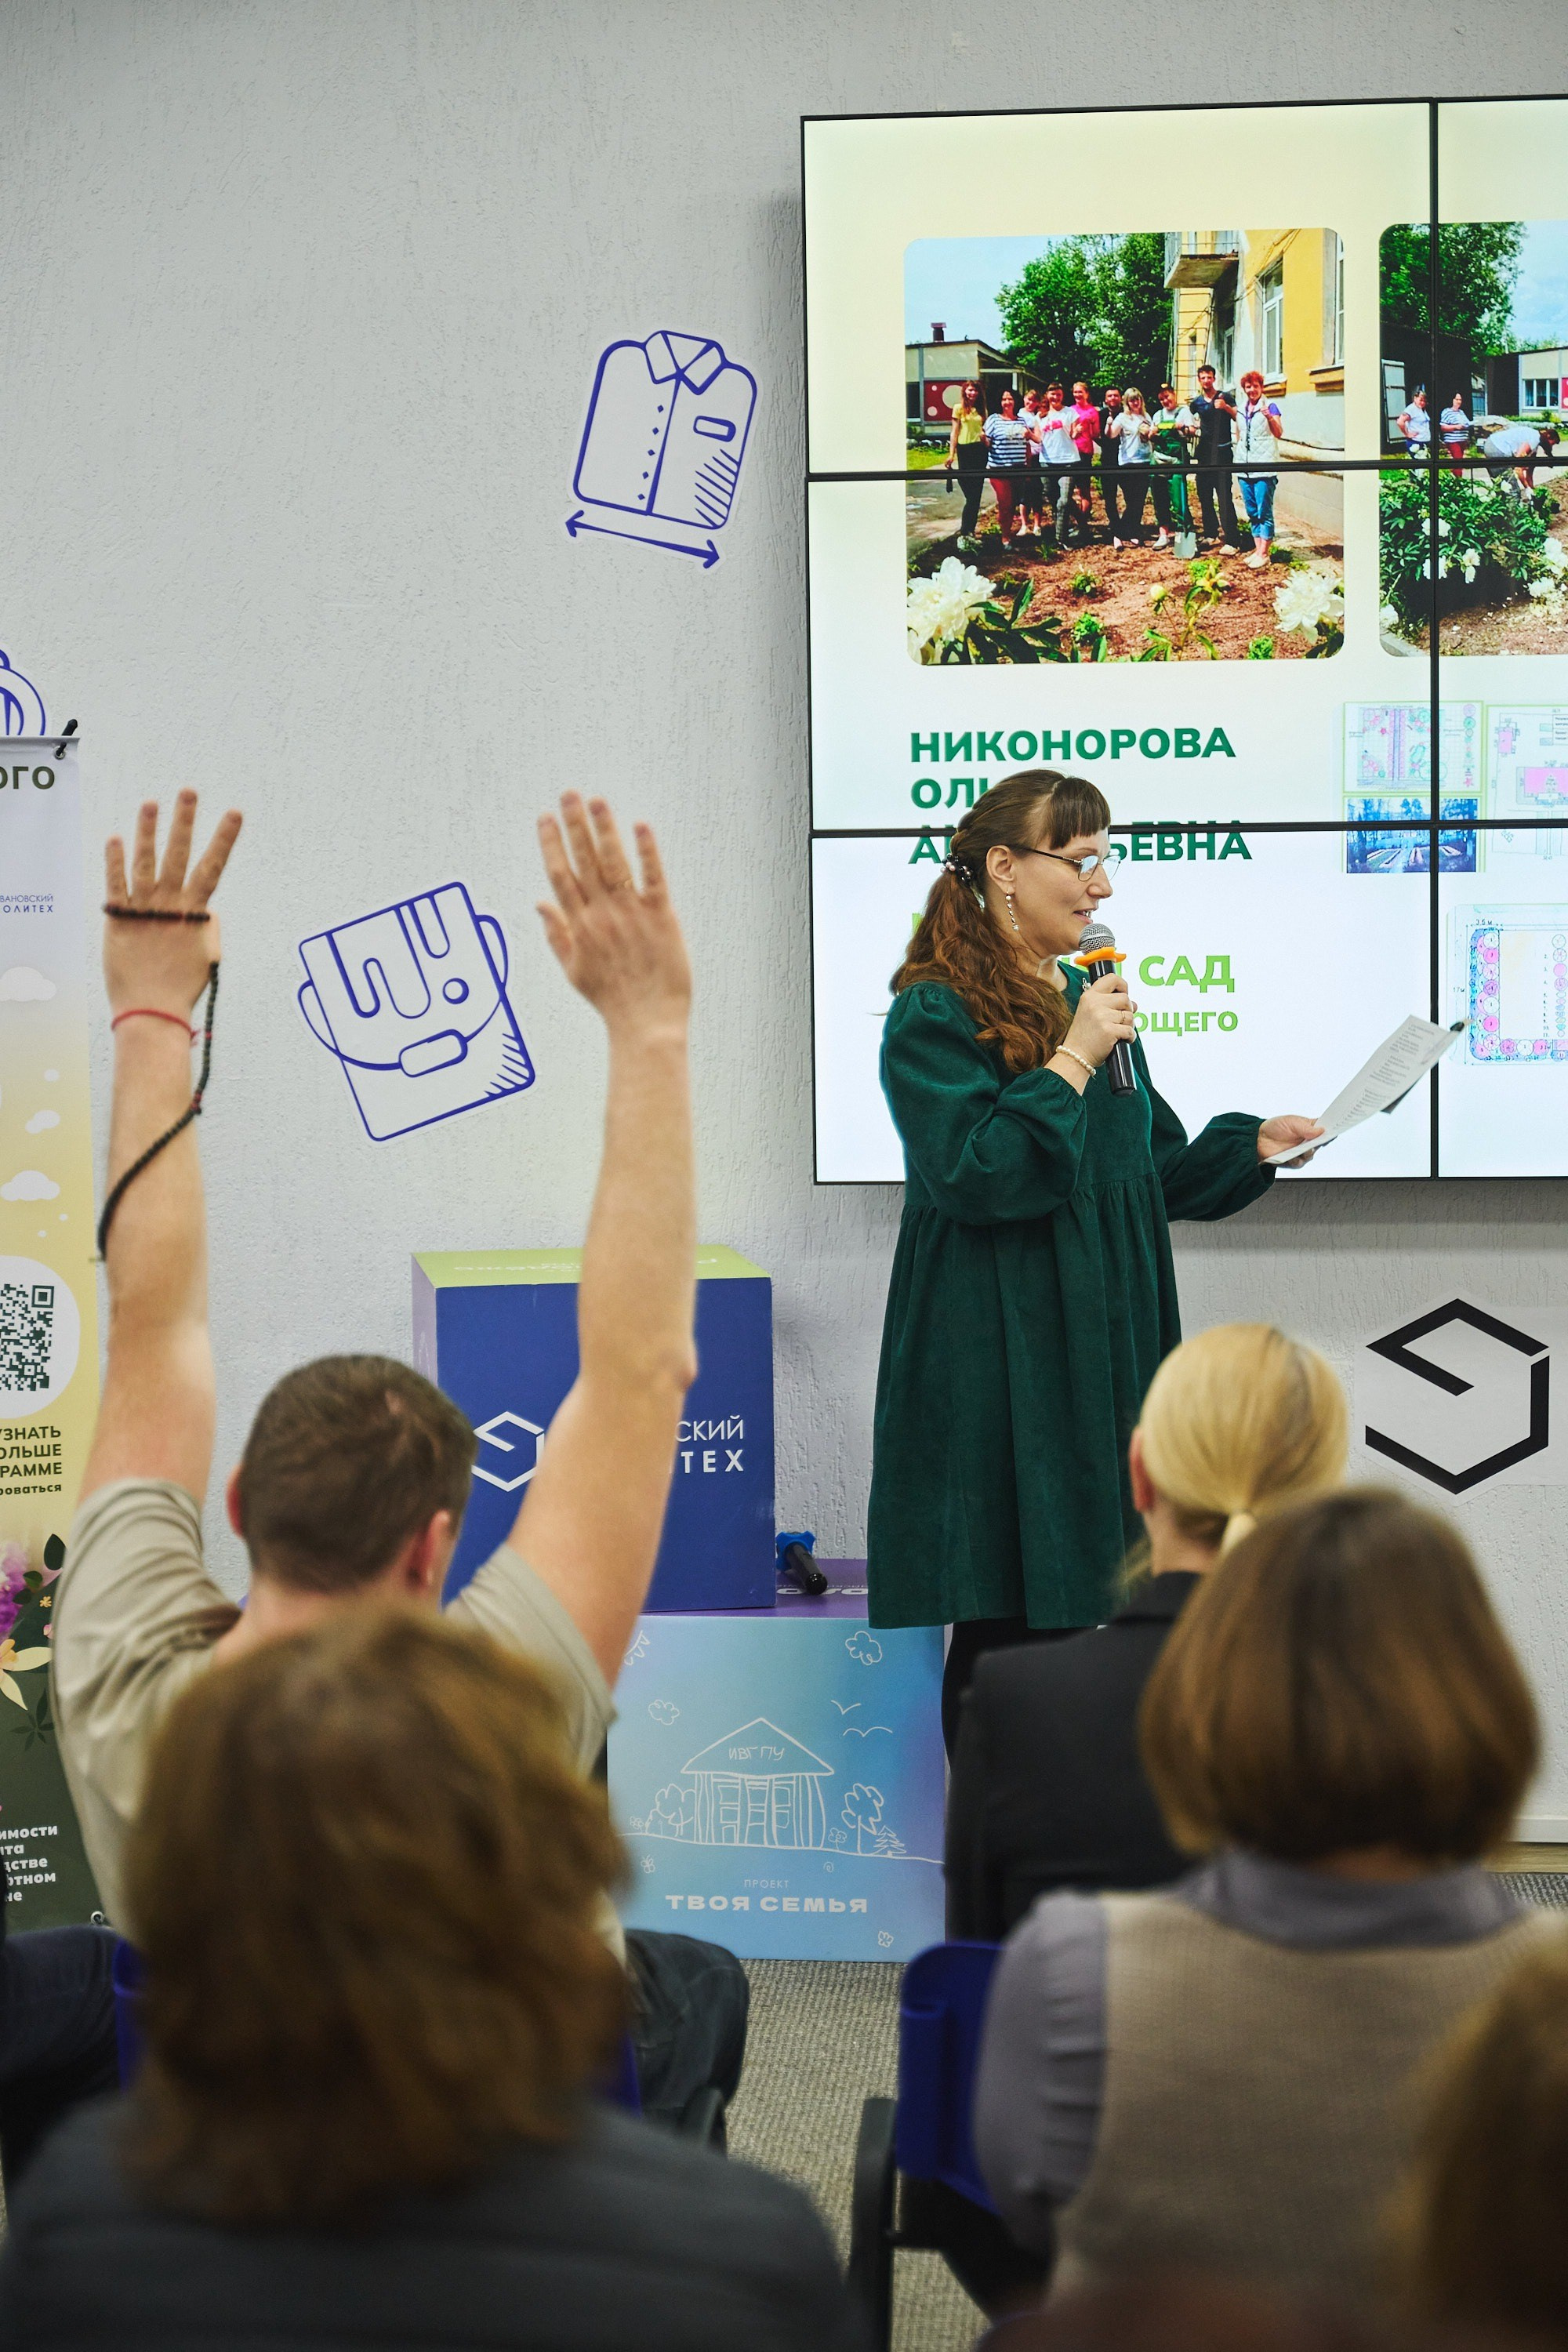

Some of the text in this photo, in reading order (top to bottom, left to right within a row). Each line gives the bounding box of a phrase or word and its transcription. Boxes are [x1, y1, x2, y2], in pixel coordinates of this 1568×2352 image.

[911, 728, 1236, 762] НИКОНОРОВА
[1139, 955, 1235, 993] САД
[0, 1425, 61, 1441] ЗНАТЬ
[743, 1878, 790, 1889] ПРОЕКТ
[665, 1894, 868, 1913] ТВОЯ СЕМЬЯ
